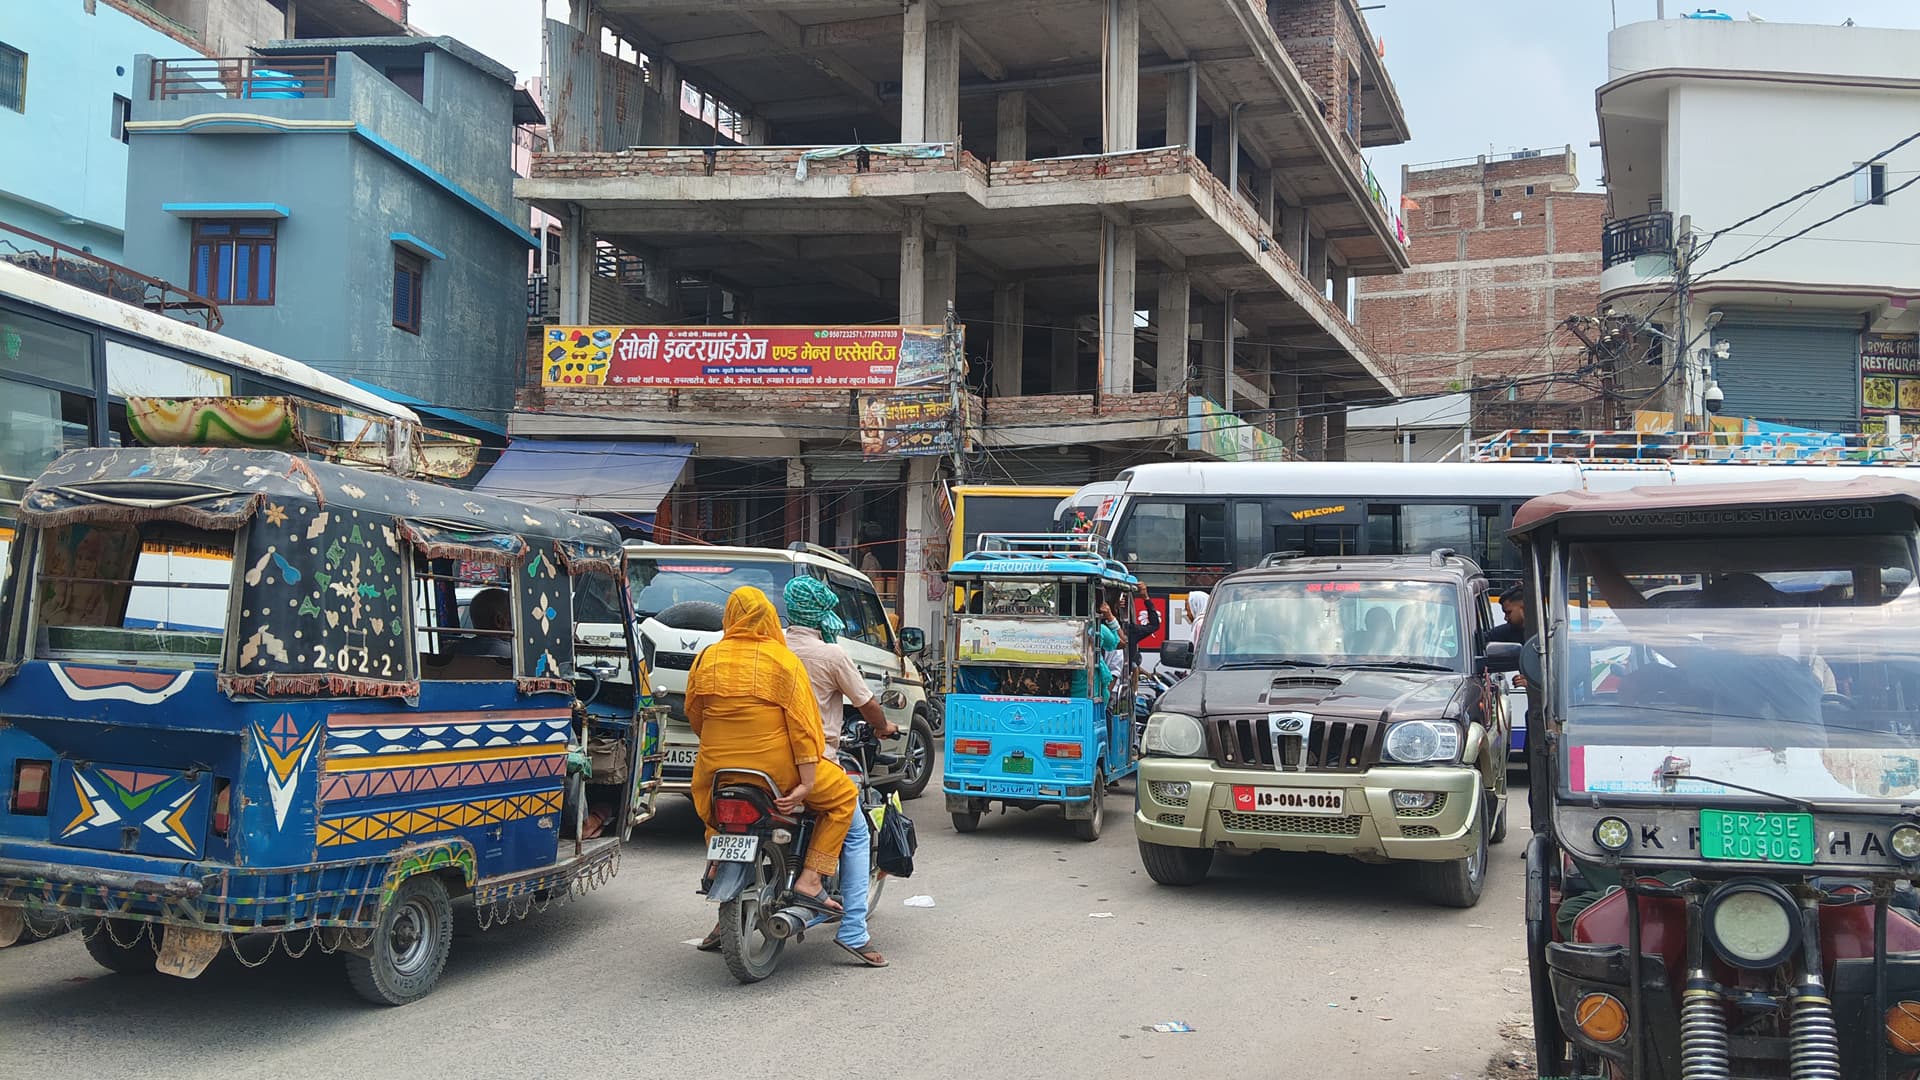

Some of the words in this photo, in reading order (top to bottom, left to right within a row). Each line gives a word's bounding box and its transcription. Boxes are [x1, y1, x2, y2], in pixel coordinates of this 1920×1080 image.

[618, 332, 660, 361] सोनी
[663, 333, 769, 363] इन्टरप्राईजेज
[772, 345, 799, 361] एण्ड
[801, 342, 832, 362] मेन्स
[834, 341, 897, 362] एस्सेसरिज
[1291, 505, 1345, 520] WELCOME
[1608, 505, 1875, 527] www.gkrickshaw.com
[984, 561, 1049, 571] AERODRIVE
[1257, 792, 1341, 809] AS-09A-8028
[1721, 814, 1800, 838] BR29E
[717, 836, 752, 849] BR28M
[1722, 835, 1802, 859] R0906
[719, 847, 748, 860] 7854
